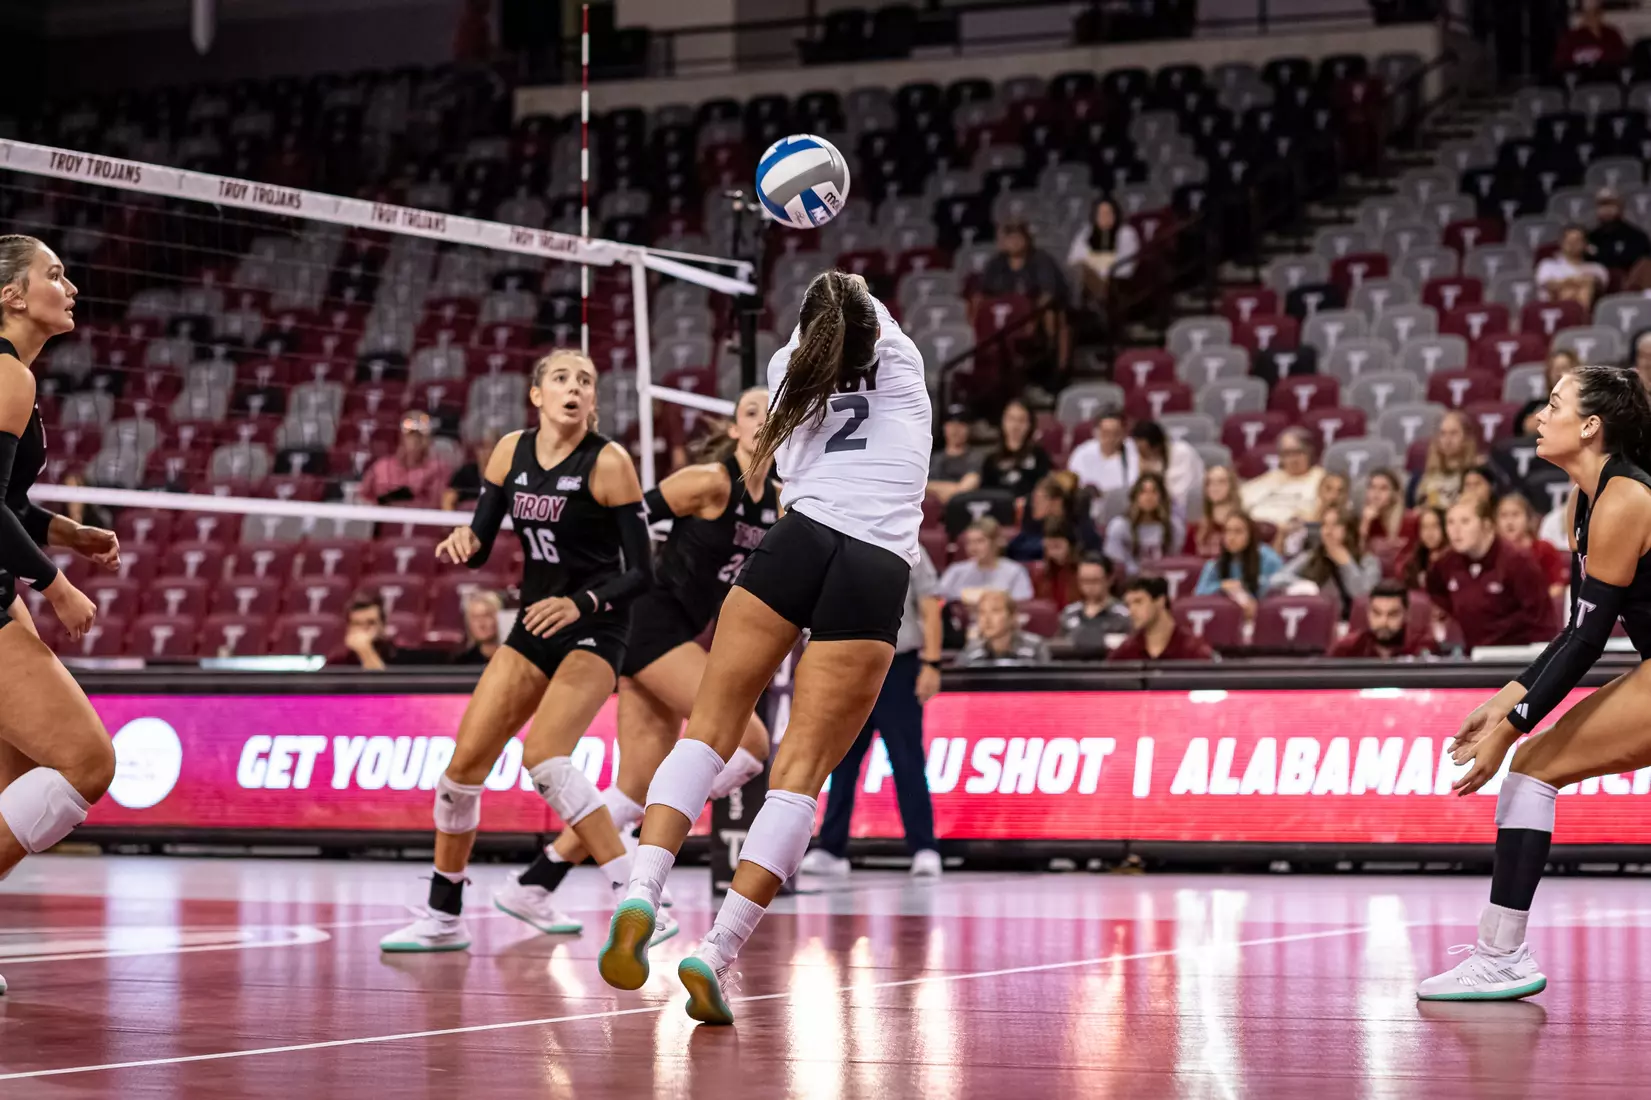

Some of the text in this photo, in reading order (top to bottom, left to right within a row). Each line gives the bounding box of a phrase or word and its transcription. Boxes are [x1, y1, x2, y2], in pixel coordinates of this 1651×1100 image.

[50, 151, 142, 184] TROY TROJANS
[219, 180, 302, 210] TROY TROJANS
[371, 204, 446, 234] TROY TROJANS
[509, 226, 578, 255] TROY TROJANS
[825, 394, 869, 454] 2
[513, 491, 567, 522] TROY
[523, 527, 560, 564] 16
[237, 735, 328, 790] GET
[331, 735, 457, 791] YOUR
[965, 736, 1116, 795] SHOT
